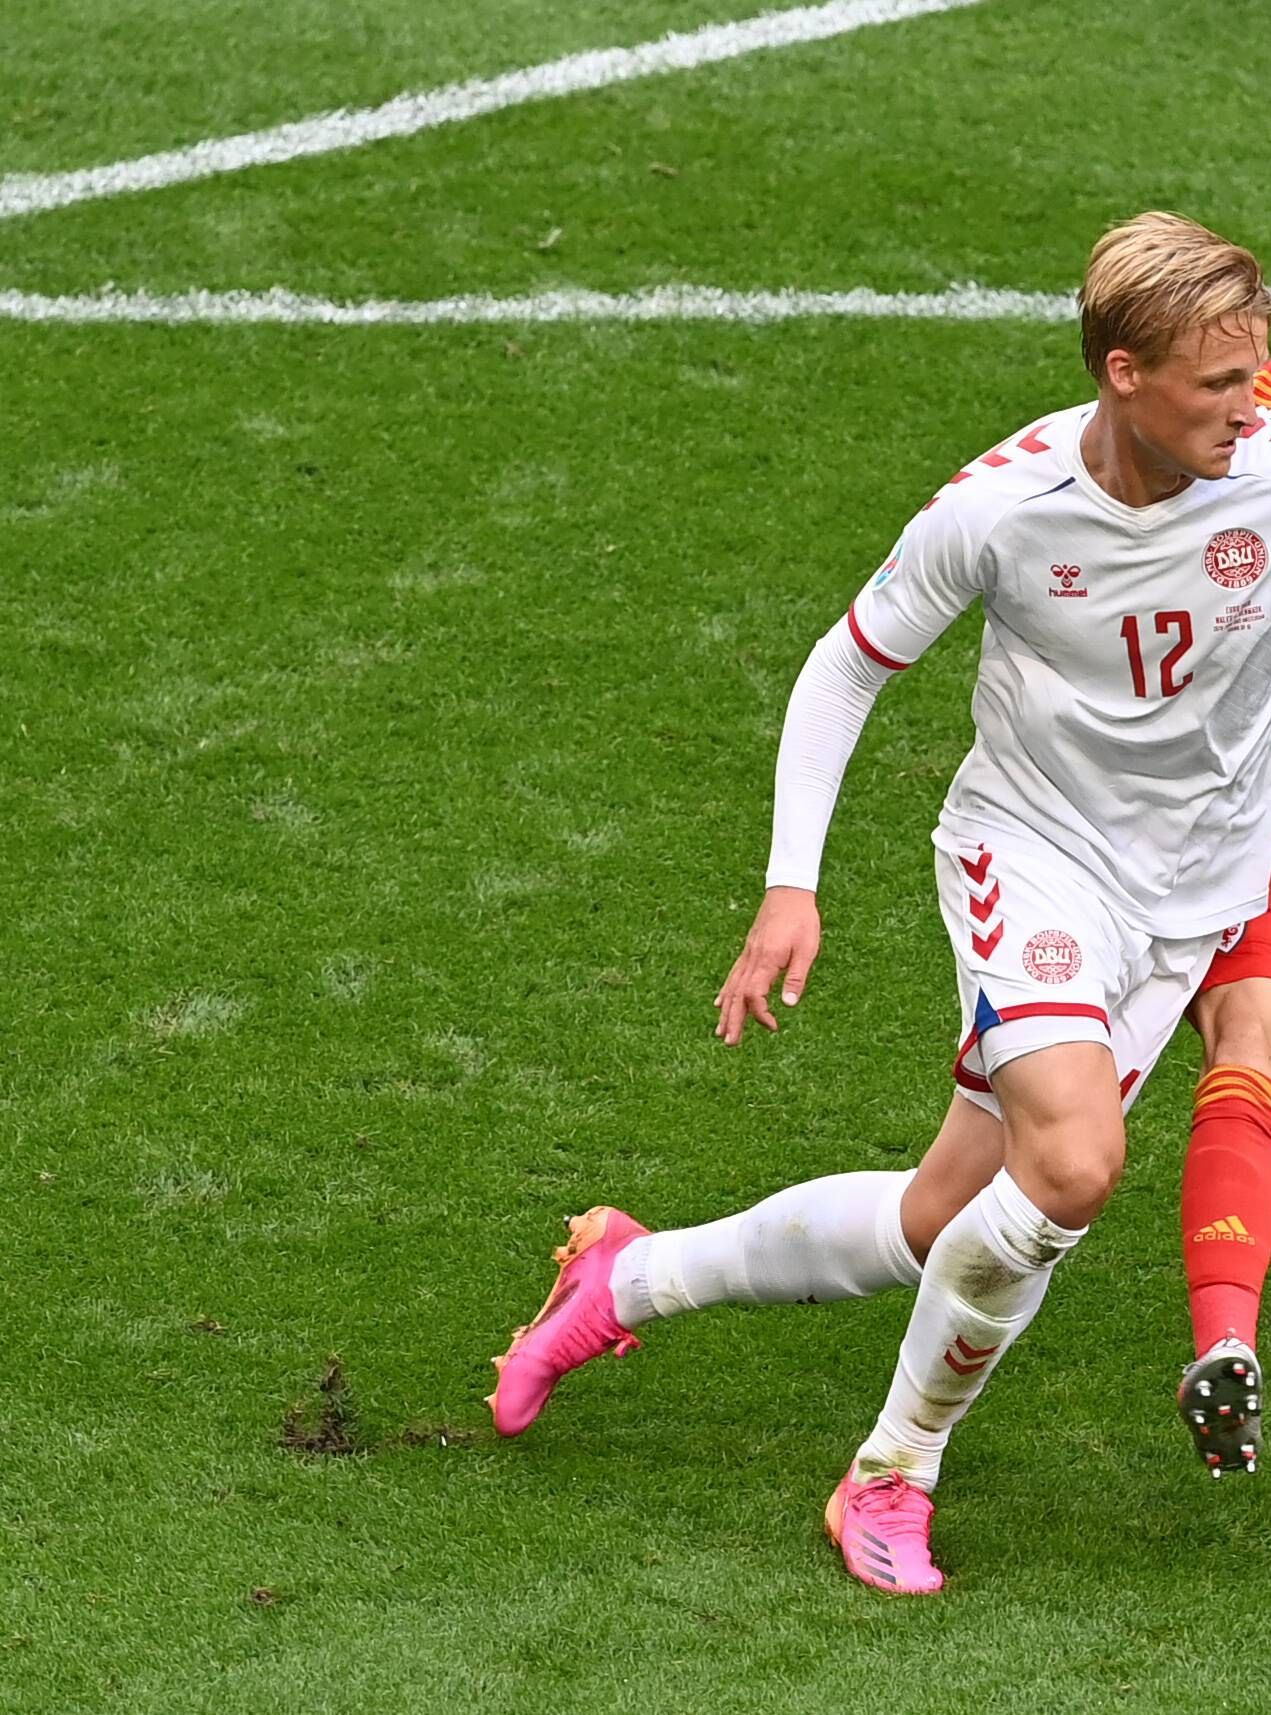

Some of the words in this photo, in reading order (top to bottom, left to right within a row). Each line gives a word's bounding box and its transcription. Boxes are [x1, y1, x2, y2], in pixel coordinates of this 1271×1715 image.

[1215, 545, 1255, 570] DBU
[1049, 587, 1088, 597] hummel
[1120, 610, 1193, 698] 12
[1034, 947, 1070, 964] DBU
[1193, 1229, 1256, 1246] adidas
